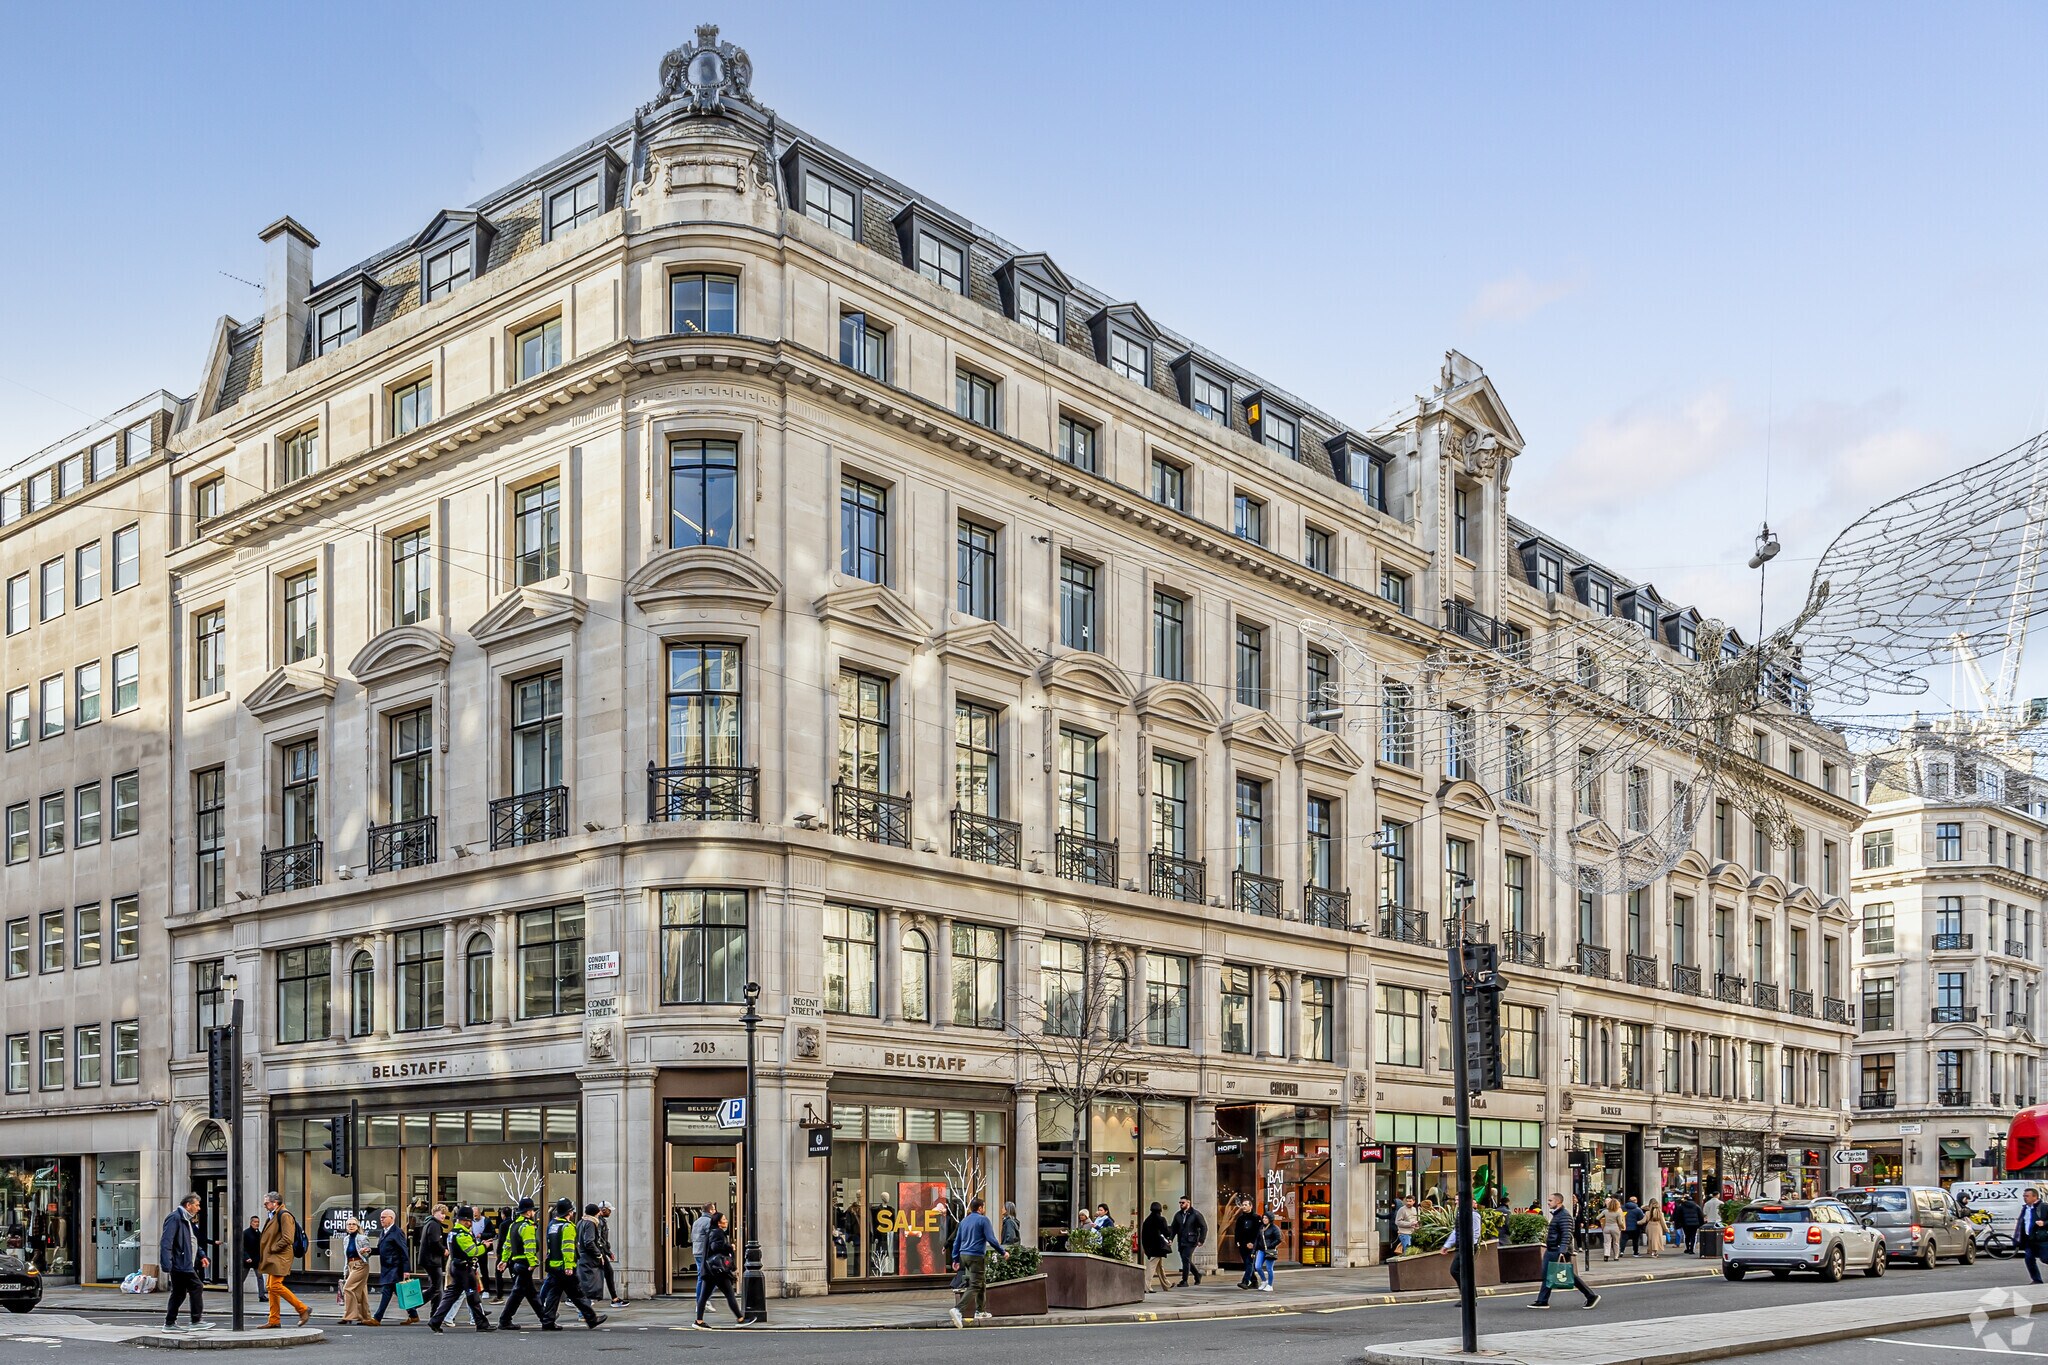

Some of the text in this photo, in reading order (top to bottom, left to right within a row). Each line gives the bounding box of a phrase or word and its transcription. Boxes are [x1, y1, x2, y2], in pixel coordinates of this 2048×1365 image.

[588, 955, 610, 963] CONDUIT
[588, 962, 606, 970] STREET
[588, 998, 616, 1008] CONDUIT
[794, 998, 818, 1007] REGENT
[588, 1008, 611, 1017] STREET
[791, 1006, 814, 1016] STREET
[692, 1042, 716, 1054] 203
[884, 1053, 966, 1071] BELSTAFF
[372, 1061, 447, 1078] BELSTAFF
[1226, 1081, 1236, 1089] 207
[1270, 1082, 1298, 1096] CAMPER
[1470, 1099, 1487, 1109] LOLA
[732, 1102, 740, 1118] P
[1600, 1106, 1622, 1116] BARKER
[1362, 1150, 1380, 1158] CAMPER
[100, 1161, 105, 1174] 2
[324, 1220, 378, 1230] CHRIMAS
[877, 1210, 940, 1232] SALE
